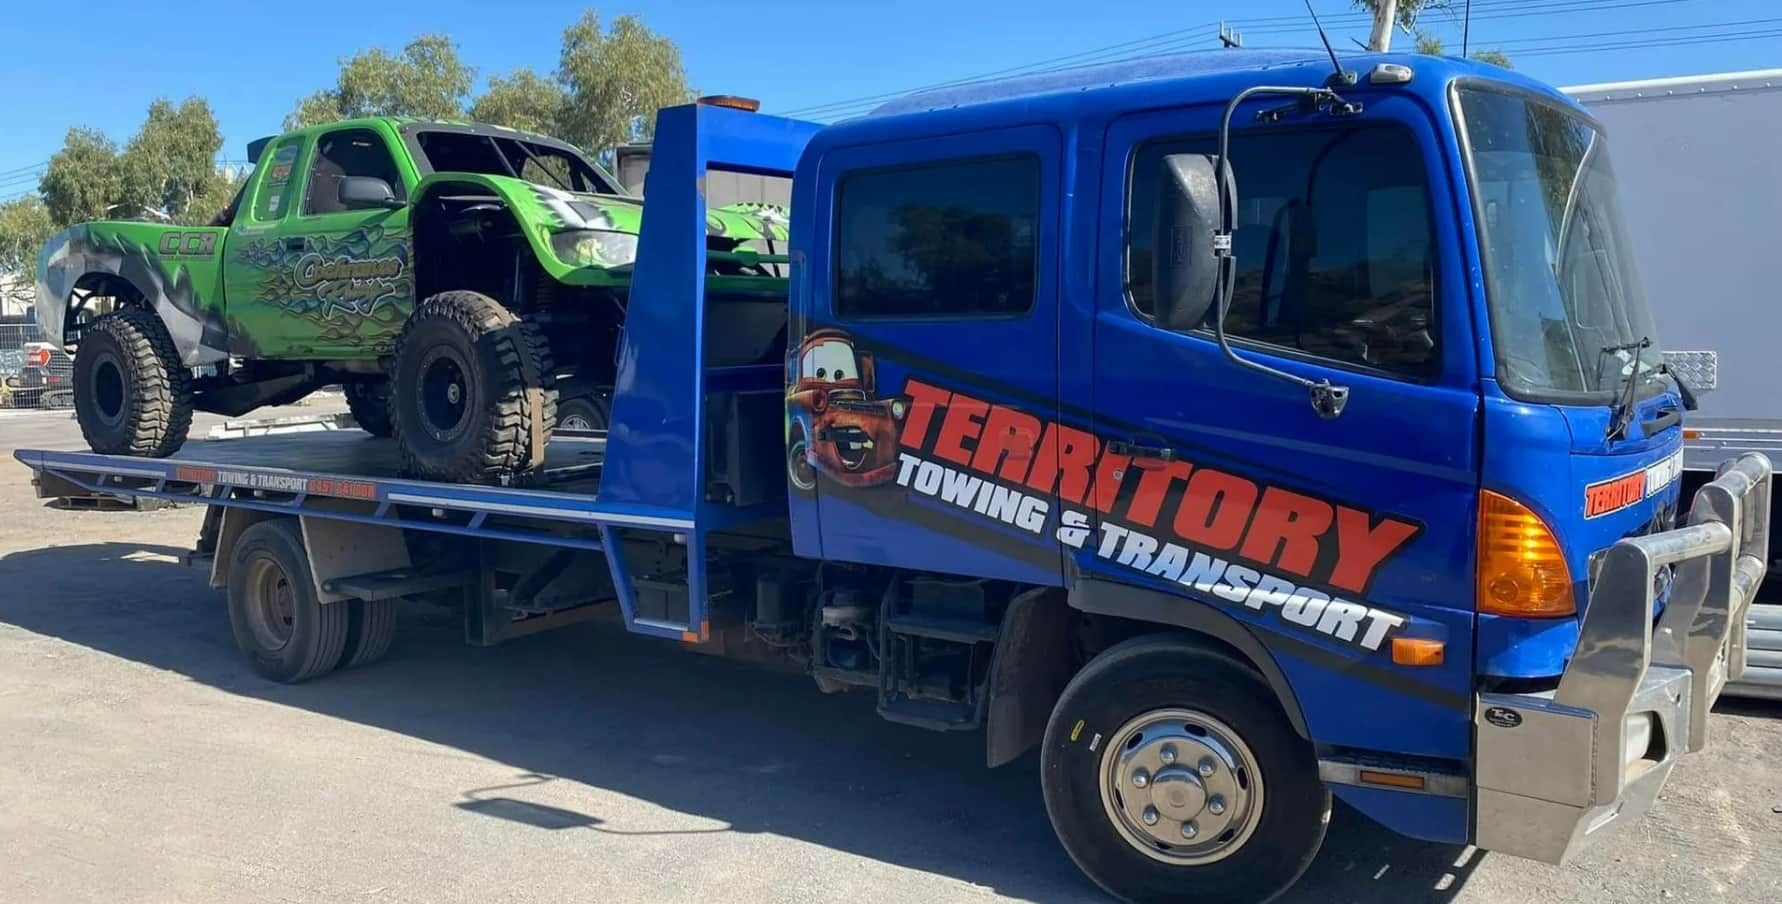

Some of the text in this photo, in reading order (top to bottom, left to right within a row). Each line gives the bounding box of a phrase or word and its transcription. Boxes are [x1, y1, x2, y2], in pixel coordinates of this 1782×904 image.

[218, 471, 249, 485] TOWING
[257, 474, 308, 491] TRANSPORT
[897, 453, 1404, 651] TOWING & TRANSPORT
[899, 379, 1418, 593] TERRITORY
